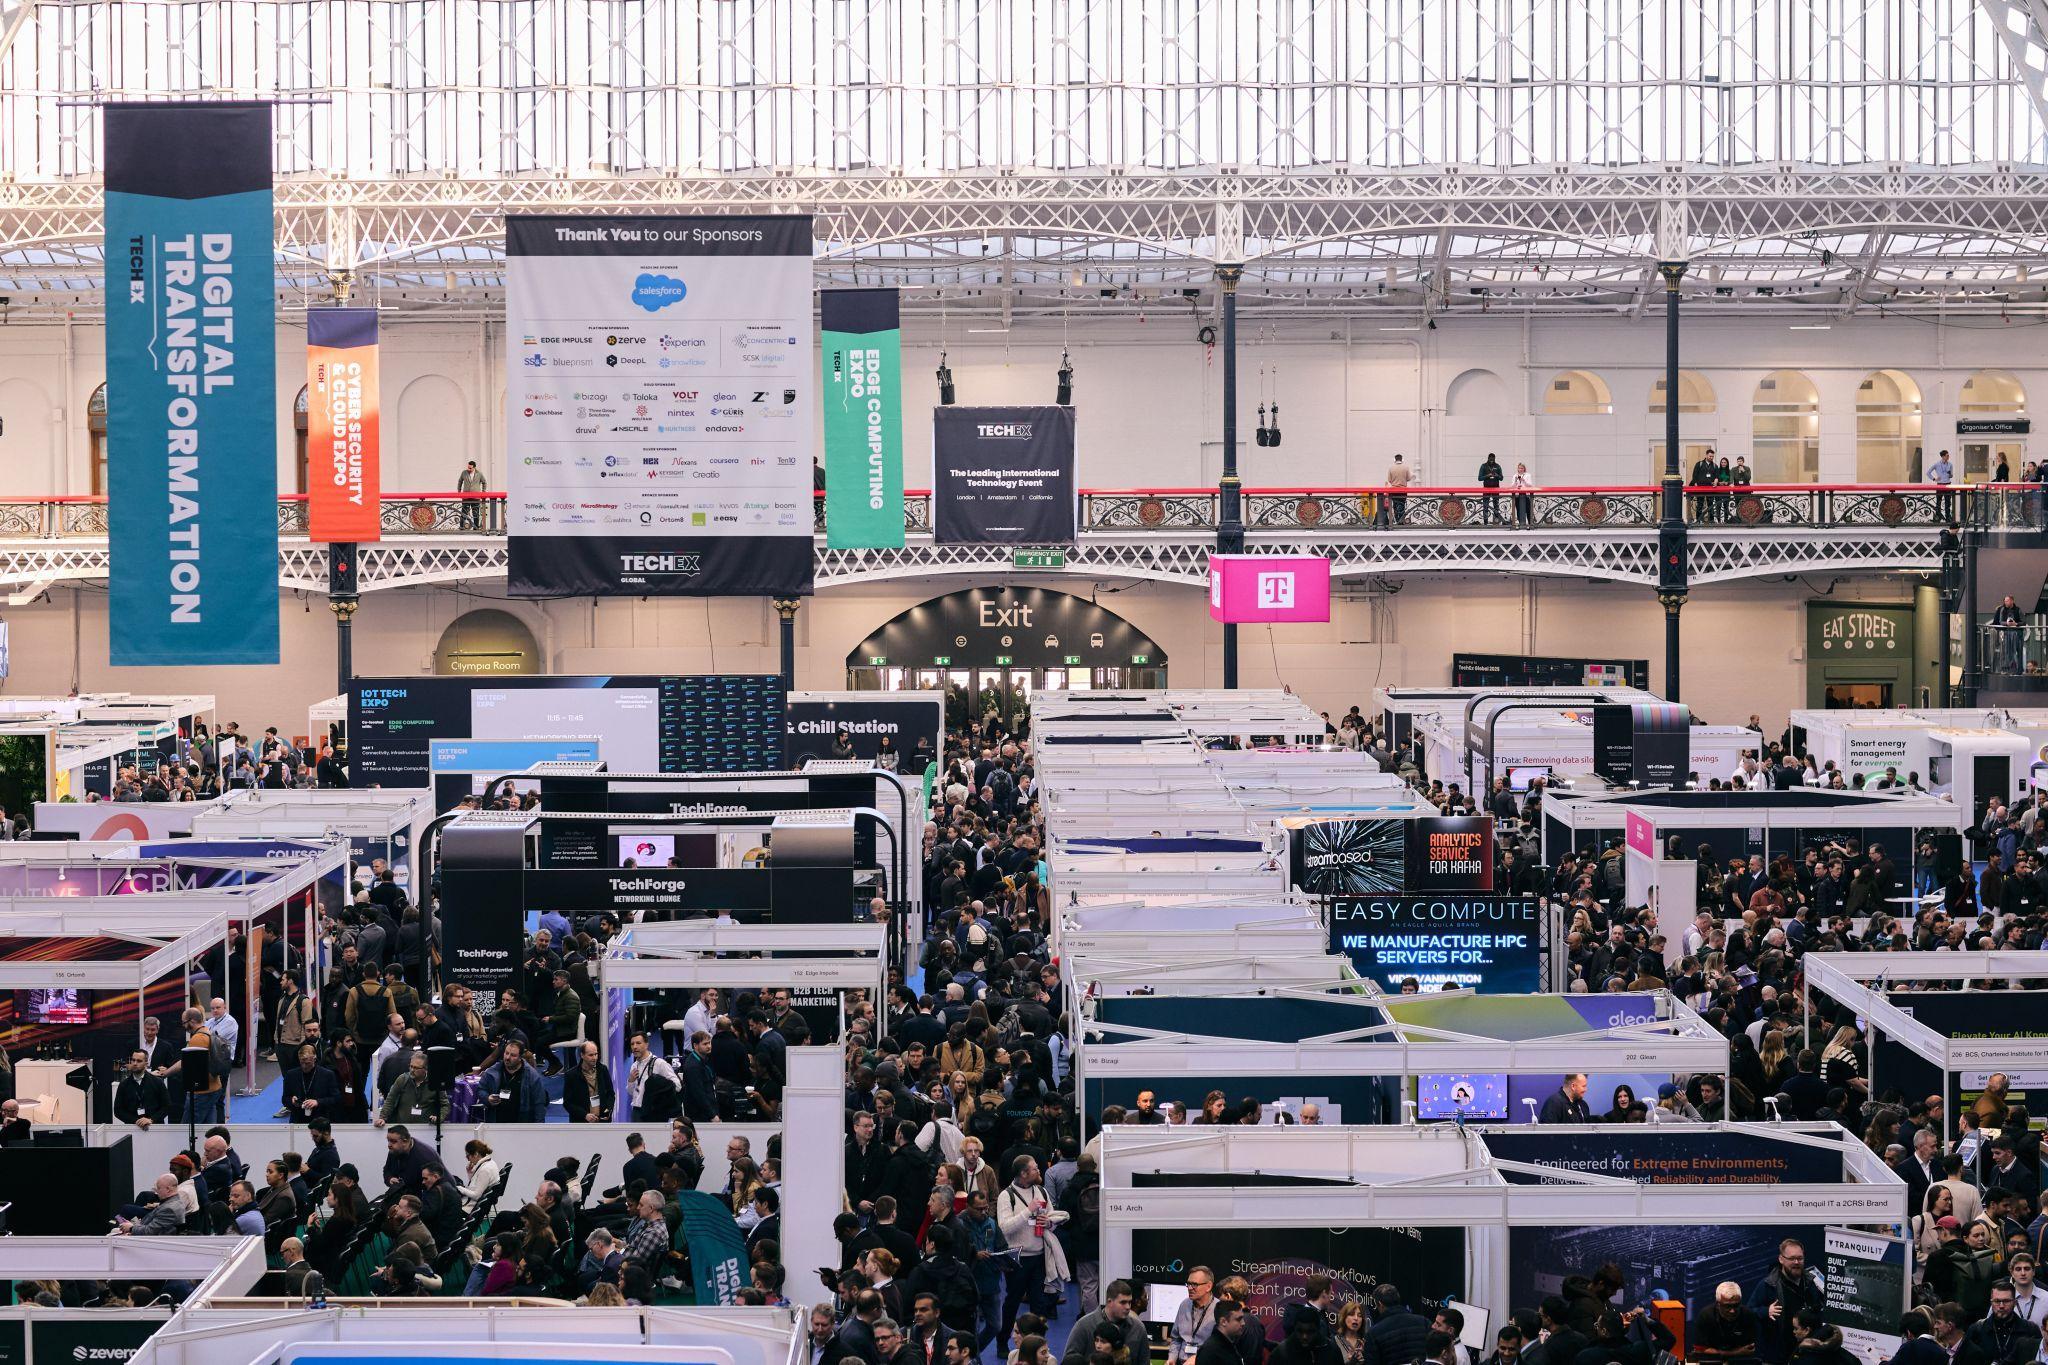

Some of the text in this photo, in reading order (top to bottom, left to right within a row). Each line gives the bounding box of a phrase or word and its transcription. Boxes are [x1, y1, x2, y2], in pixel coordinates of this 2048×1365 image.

[555, 228, 763, 245] Thank You to our Sponsors
[130, 235, 145, 304] TECHEX
[639, 286, 682, 297] salesforce
[202, 233, 234, 395] DIGITAL
[665, 338, 706, 348] experian
[553, 358, 593, 367] blueprism
[850, 350, 864, 398] EXPO
[581, 393, 608, 402] bizagi
[632, 393, 658, 401] Toloka
[673, 391, 699, 399] VOLT
[713, 392, 737, 402] glean
[333, 379, 347, 438] CLOUD
[667, 409, 695, 417] nintex
[164, 234, 201, 624] TRANSFORMATION
[347, 362, 363, 506] CYBER SECURITY
[866, 350, 884, 510] EDGE COMPUTING
[977, 424, 1032, 437] TECHEX
[333, 441, 347, 486] EXPO
[692, 471, 720, 479] Creatio
[950, 469, 1060, 479] The Leading International
[967, 479, 1043, 489] Technology Event
[620, 555, 700, 571] TECHEX
[979, 600, 1033, 628] Exit
[1823, 613, 1897, 638] EAT STREET
[493, 661, 521, 670] Room
[361, 689, 407, 698] IOT TECH
[361, 698, 389, 707] EXPO
[798, 720, 836, 734] Chill
[838, 719, 899, 734] Station
[1850, 739, 1907, 749] Smart energy
[1501, 754, 1719, 766] Data: Removing data silo savings
[1850, 759, 1903, 768] for everyone
[669, 803, 748, 813] TechForge
[1429, 833, 1482, 847] ANALYTICS
[1429, 847, 1470, 860] SERVICE
[1429, 860, 1482, 874] FOR KAFKA
[129, 872, 197, 895] CRM
[609, 878, 686, 892] TechForge
[1335, 902, 1536, 920] EASY COMPUTE
[1343, 935, 1527, 948] WE MANUFACTURE HPC
[457, 949, 509, 959] TechForge
[1376, 951, 1493, 964] SERVERS FOR...
[793, 987, 834, 995] B2B TECH
[790, 997, 838, 1007] MARKETING
[1951, 1031, 1987, 1039] Elevate
[1990, 1031, 2010, 1039] Your
[2025, 1031, 2048, 1039] Know
[1534, 1157, 1788, 1170] Engineered for Extreme Environments,
[1653, 1174, 1704, 1184] Reliability
[1707, 1174, 1727, 1183] and
[1729, 1174, 1781, 1184] Durability.
[1109, 1204, 1143, 1212] 194 Arch
[1781, 1200, 1794, 1208] 191
[1798, 1200, 1826, 1209] Tranquil
[1827, 1257, 1847, 1267] BUILT
[1231, 1259, 1377, 1286] Streamlined workflows
[1827, 1265, 1837, 1273] TO
[1827, 1274, 1855, 1286] ENDURE
[1826, 1283, 1858, 1295] CRAFTED
[1337, 1290, 1378, 1310] visibility
[1826, 1291, 1845, 1301] WITH
[1826, 1300, 1862, 1313] PRECISION
